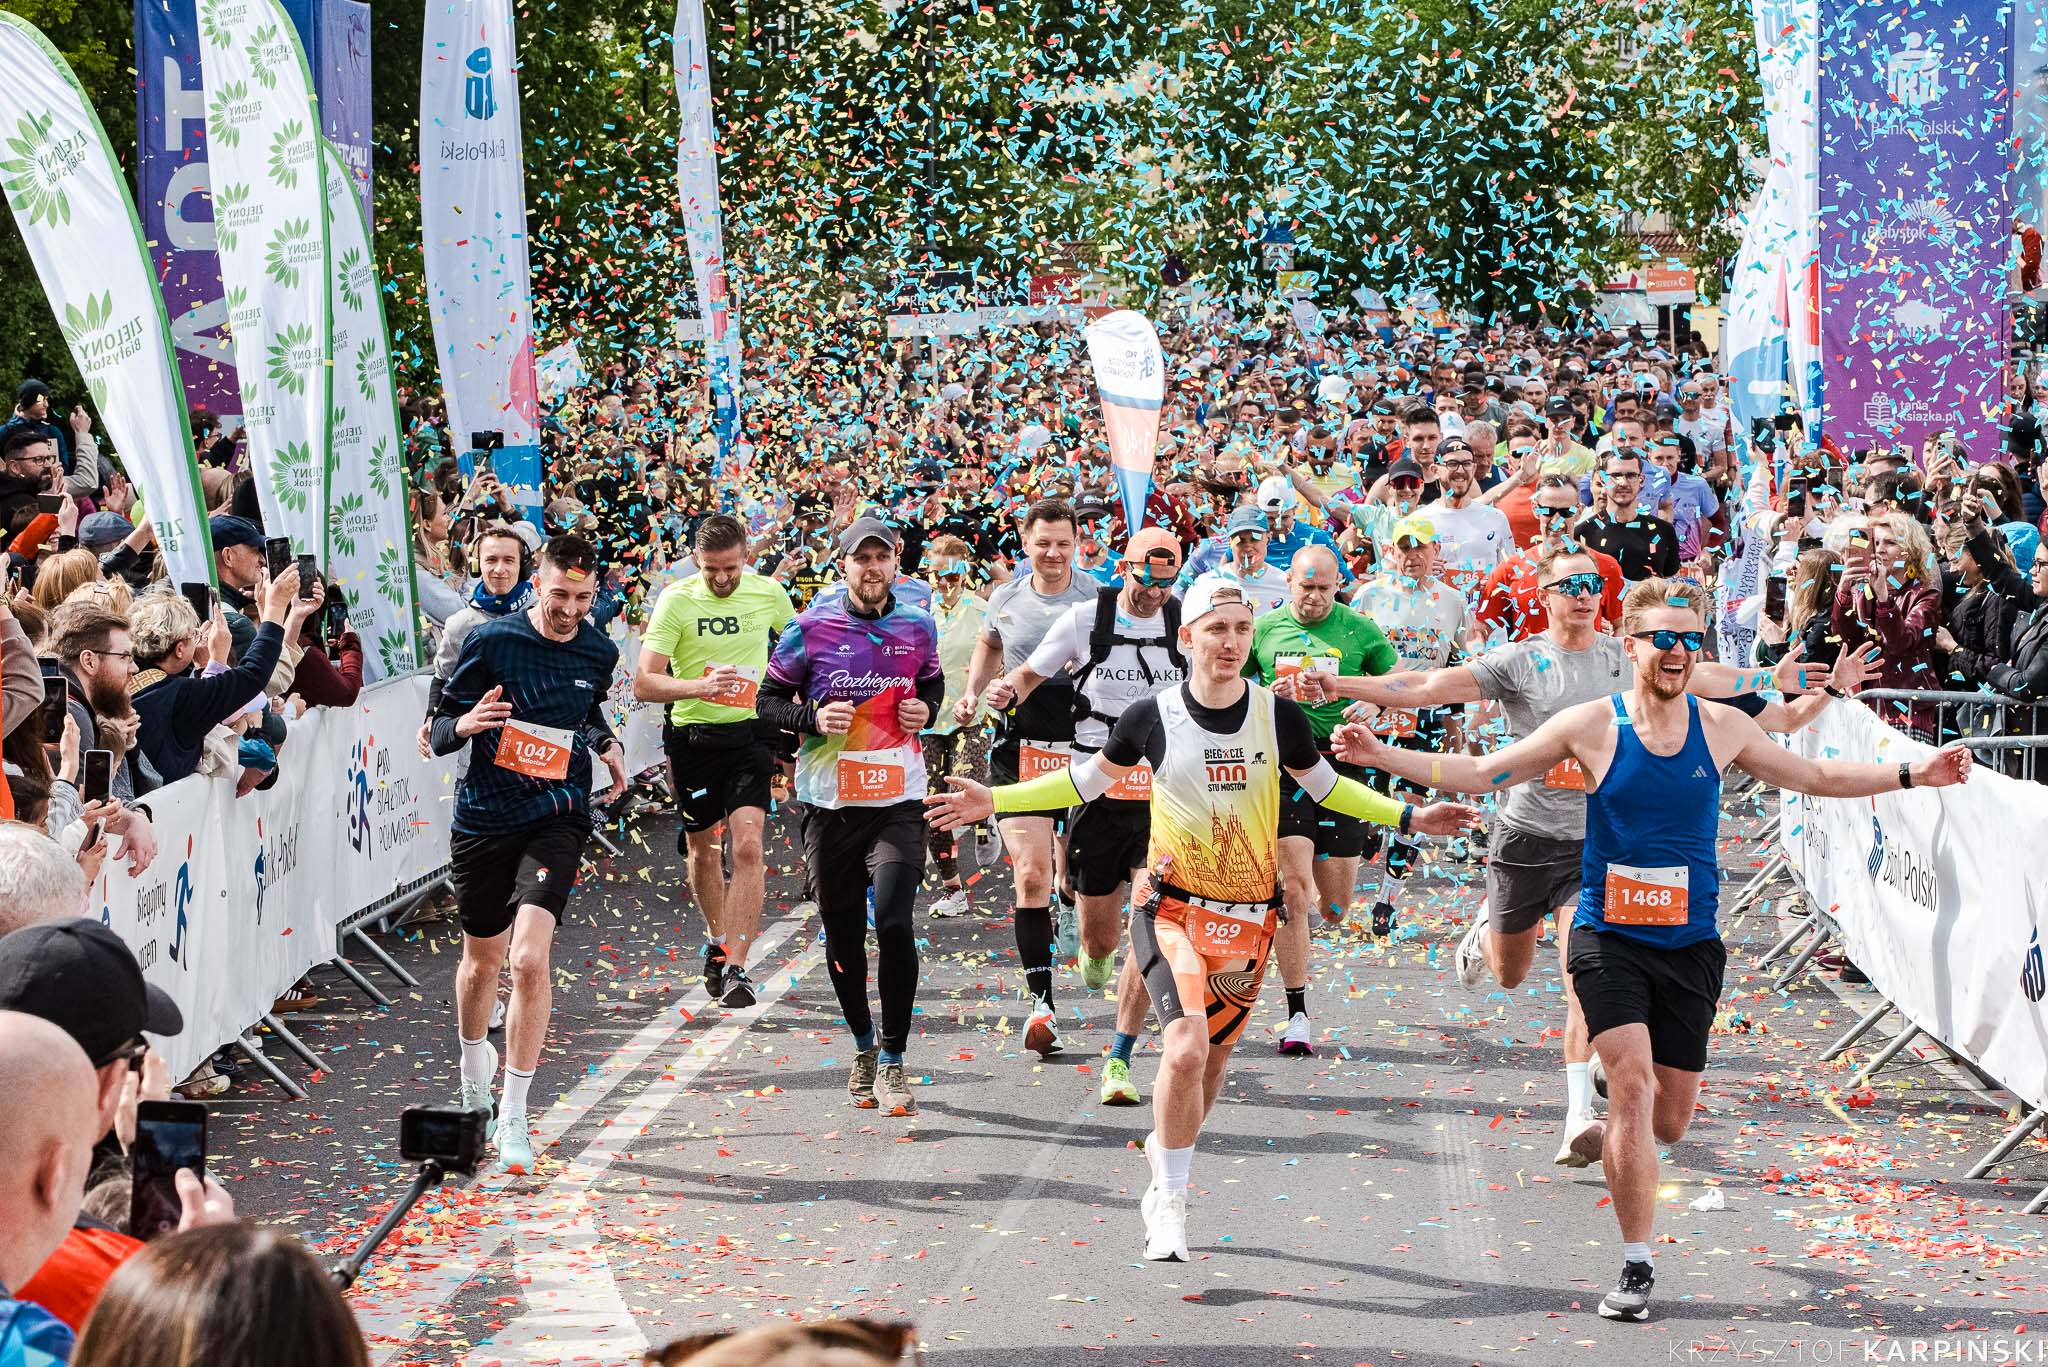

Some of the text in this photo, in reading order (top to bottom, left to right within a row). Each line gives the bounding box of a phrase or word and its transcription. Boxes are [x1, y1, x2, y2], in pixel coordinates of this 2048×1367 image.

[1867, 225, 1927, 242] Bałystok
[1678, 276, 1687, 287] C
[697, 616, 740, 637] FOB
[828, 669, 914, 695] Rozbiegamy
[1095, 667, 1182, 682] PACEMAKE
[829, 689, 877, 697] CAŁE MIASTO
[514, 741, 559, 762] 1047
[1032, 756, 1069, 770] 1005
[857, 768, 888, 785] 128
[1208, 782, 1247, 792] STU MOSTÓW
[1903, 849, 1938, 913] Polski
[1621, 888, 1672, 907] 1468
[1204, 921, 1242, 939] 969
[1211, 938, 1231, 946] Jakub
